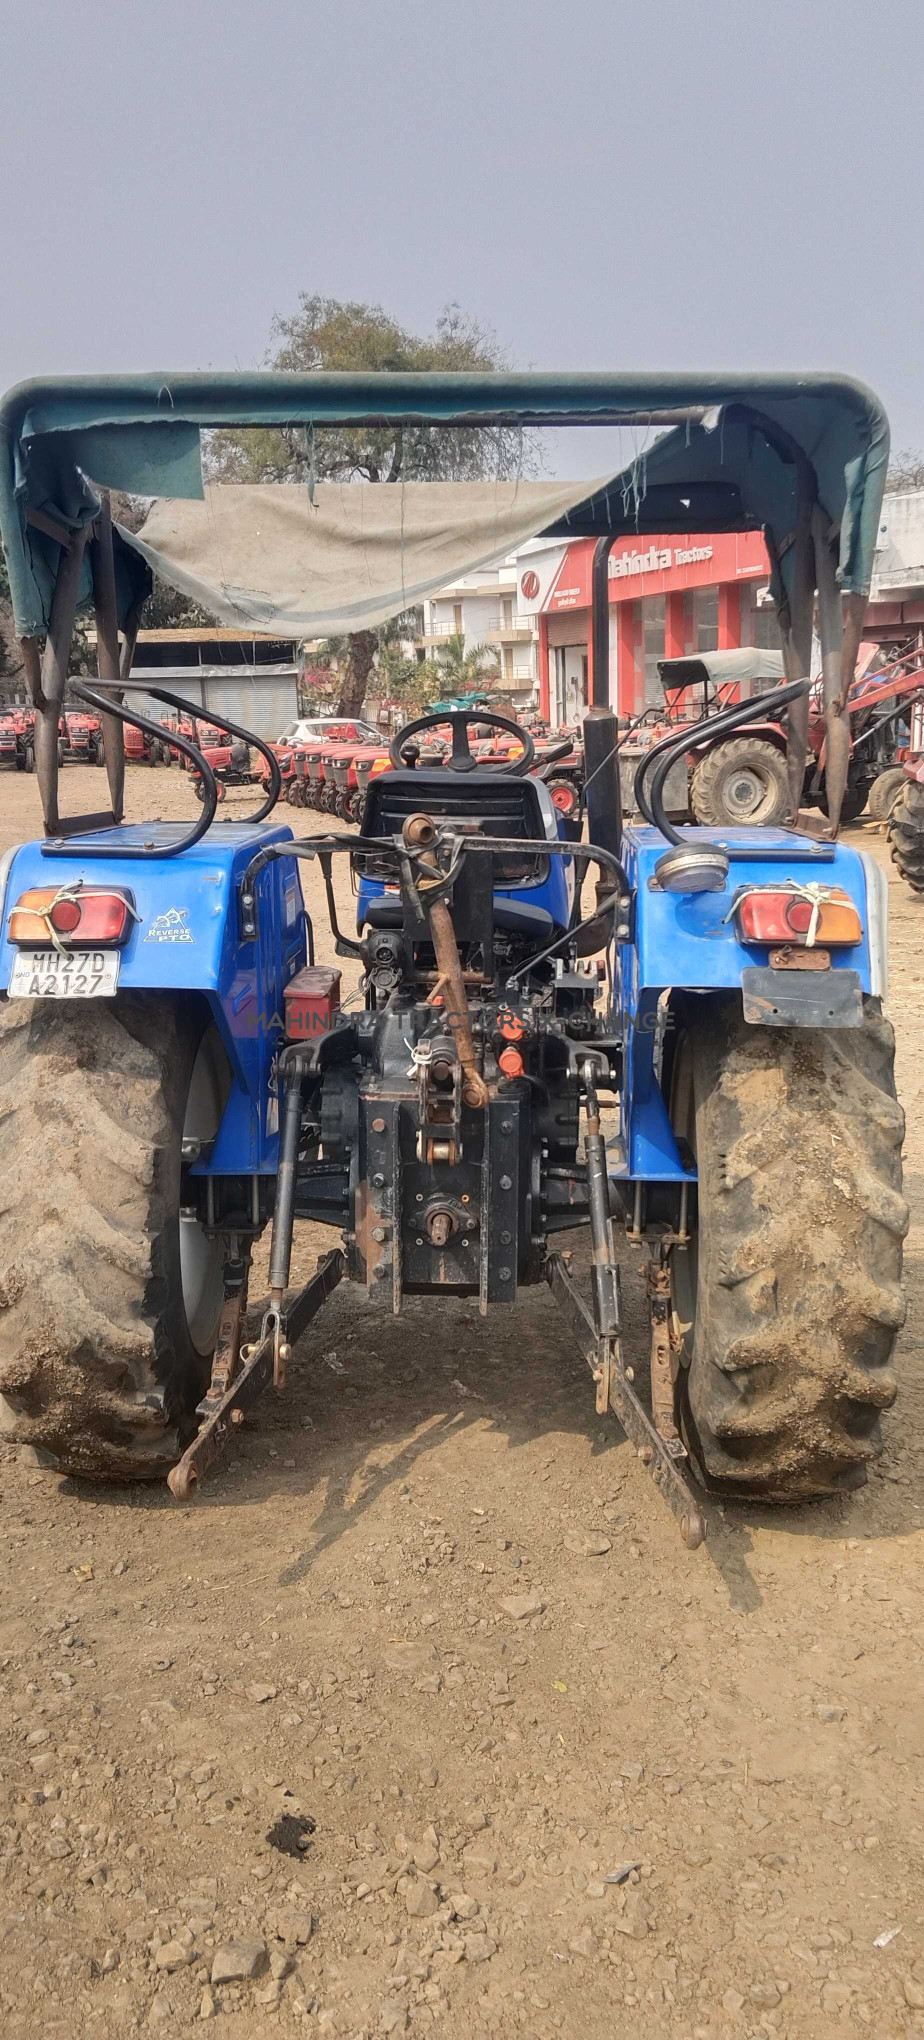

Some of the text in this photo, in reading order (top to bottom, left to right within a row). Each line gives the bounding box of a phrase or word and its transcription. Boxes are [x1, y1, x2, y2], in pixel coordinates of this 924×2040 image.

[674, 546, 713, 565] Tractors
[149, 928, 191, 938] REVERSE
[158, 934, 191, 942] PTO
[32, 953, 105, 973] MH27D
[29, 974, 103, 995] A2127
